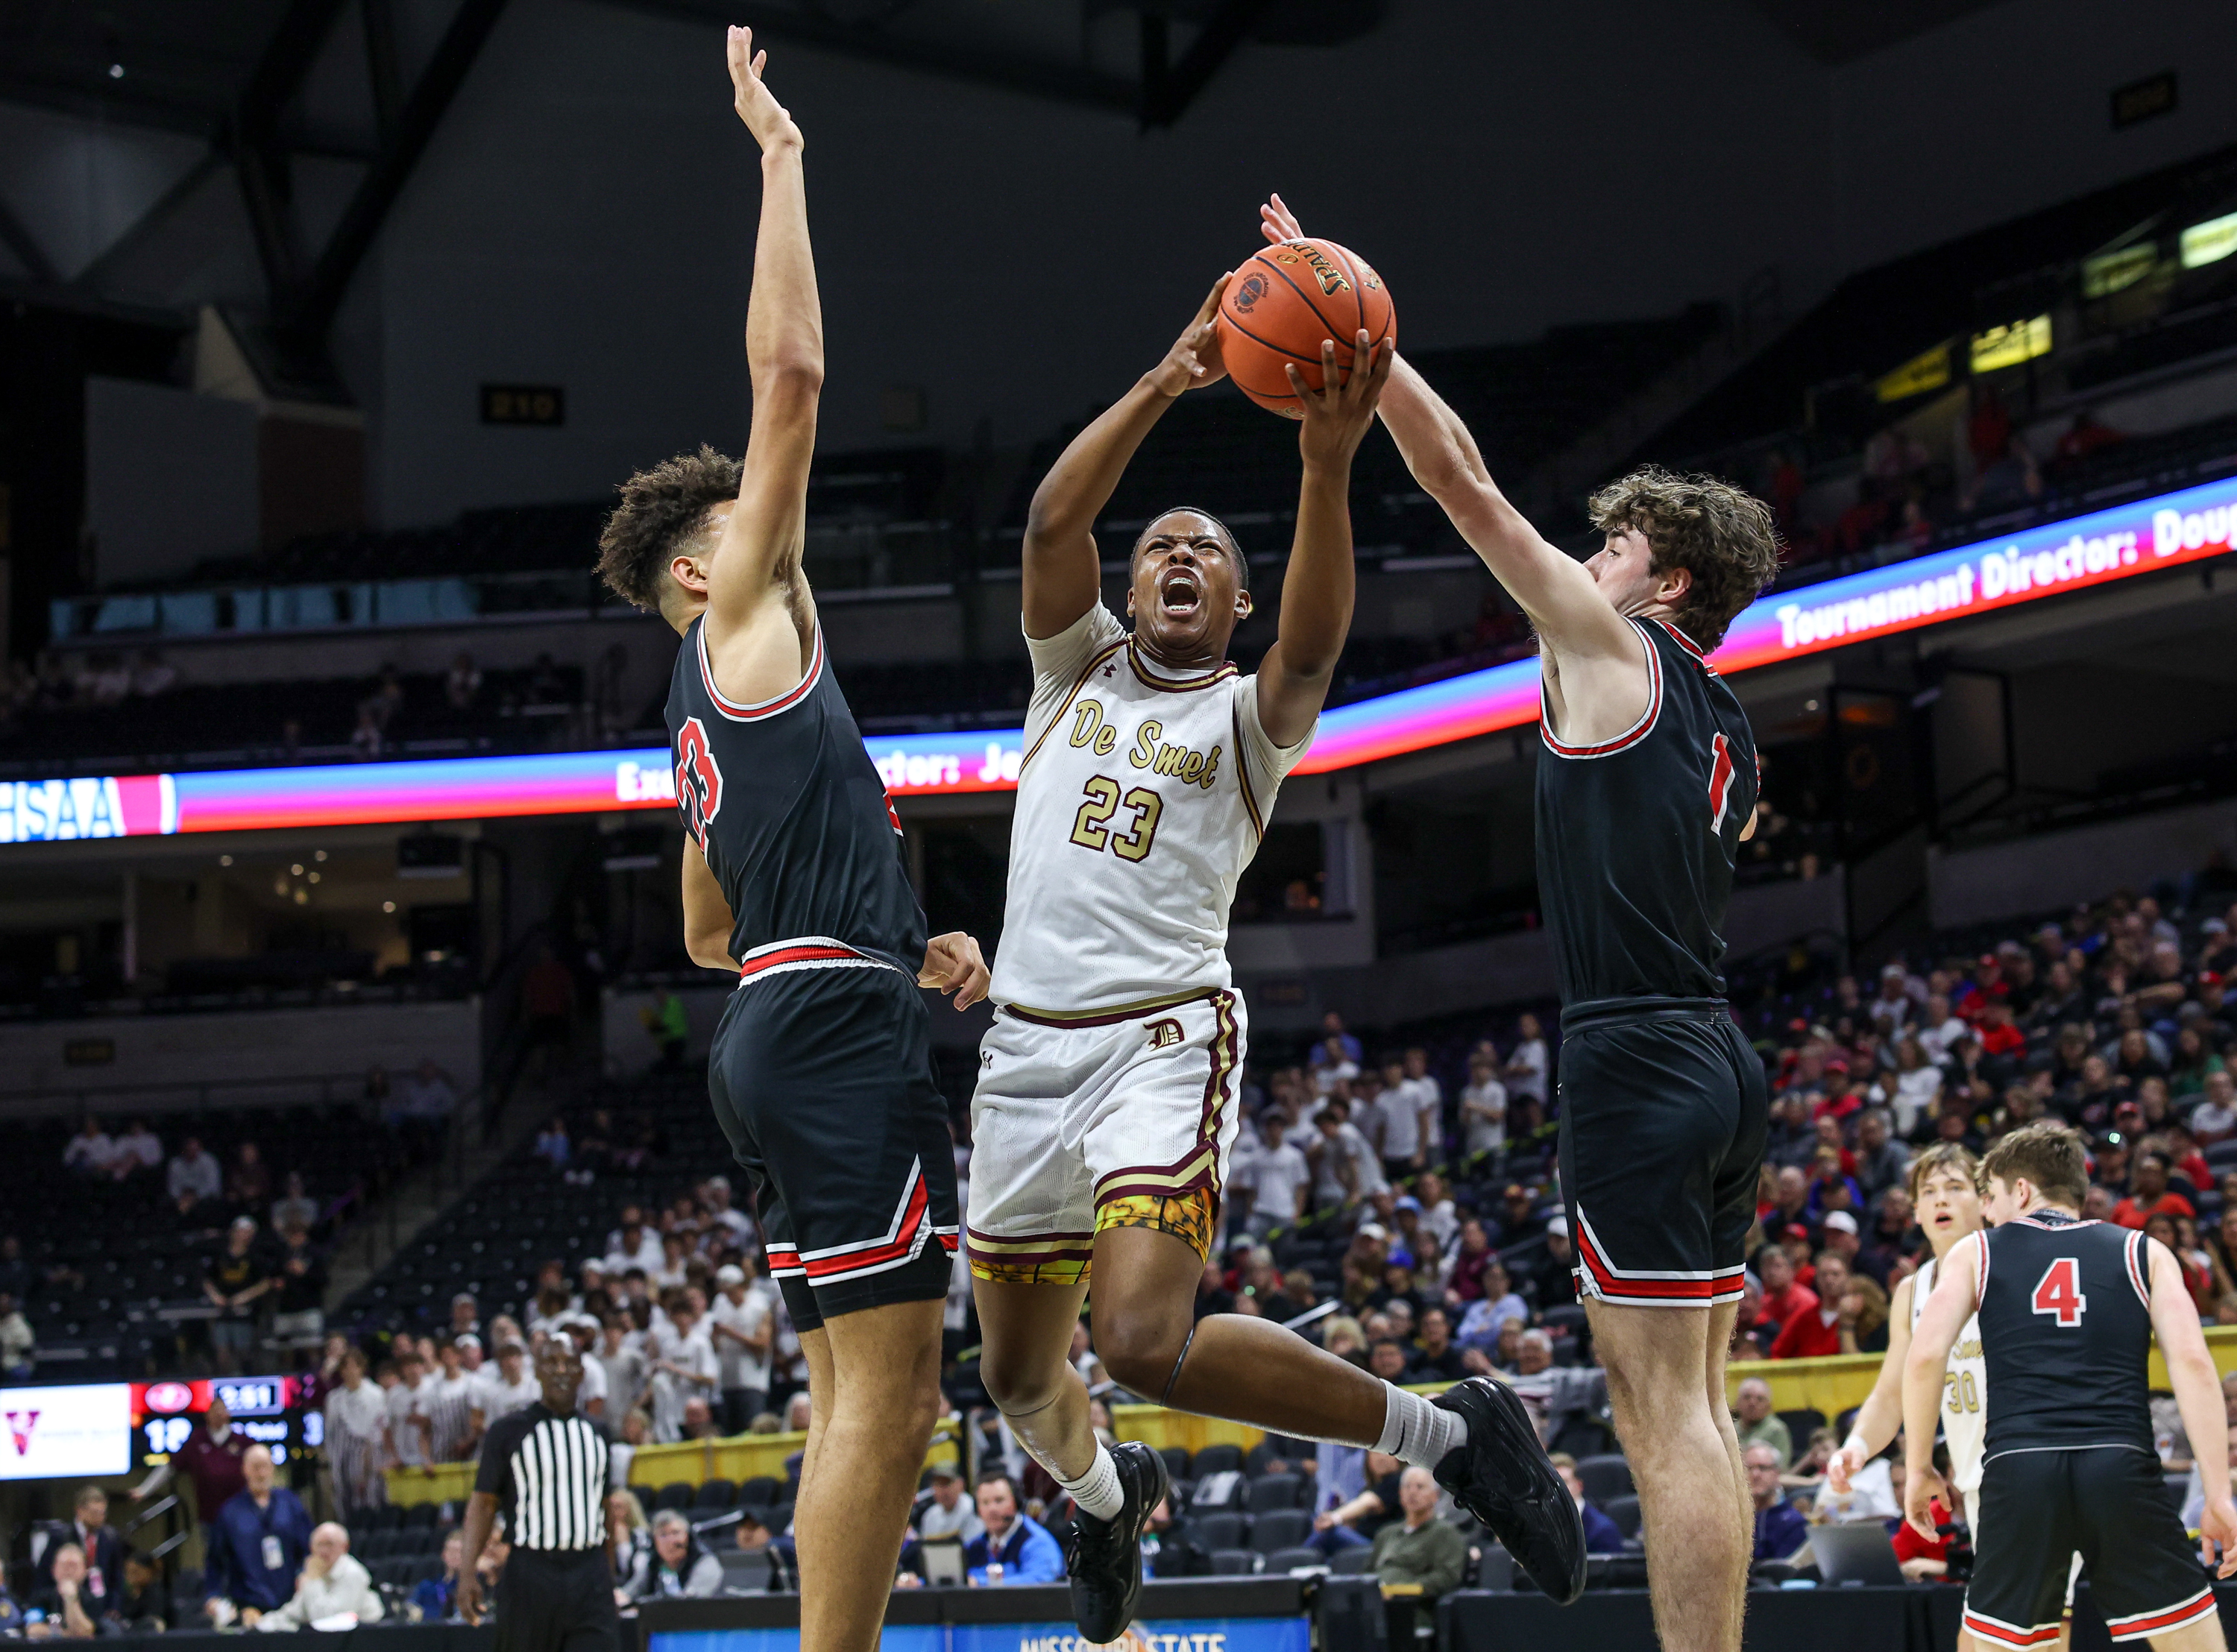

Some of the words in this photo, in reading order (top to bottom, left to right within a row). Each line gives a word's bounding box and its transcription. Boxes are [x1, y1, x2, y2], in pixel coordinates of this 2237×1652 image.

[1281, 240, 1351, 296] SPALD
[1776, 563, 1975, 649] Tournament
[1980, 529, 2139, 599] Director:
[978, 742, 1025, 785] Jo
[1069, 699, 1116, 756] De
[1129, 720, 1222, 789] Smet
[1069, 775, 1164, 863] 23
[2030, 1257, 2087, 1327] 4
[1945, 1370, 1980, 1413] 30
[1145, 1632, 1227, 1652] STATE
